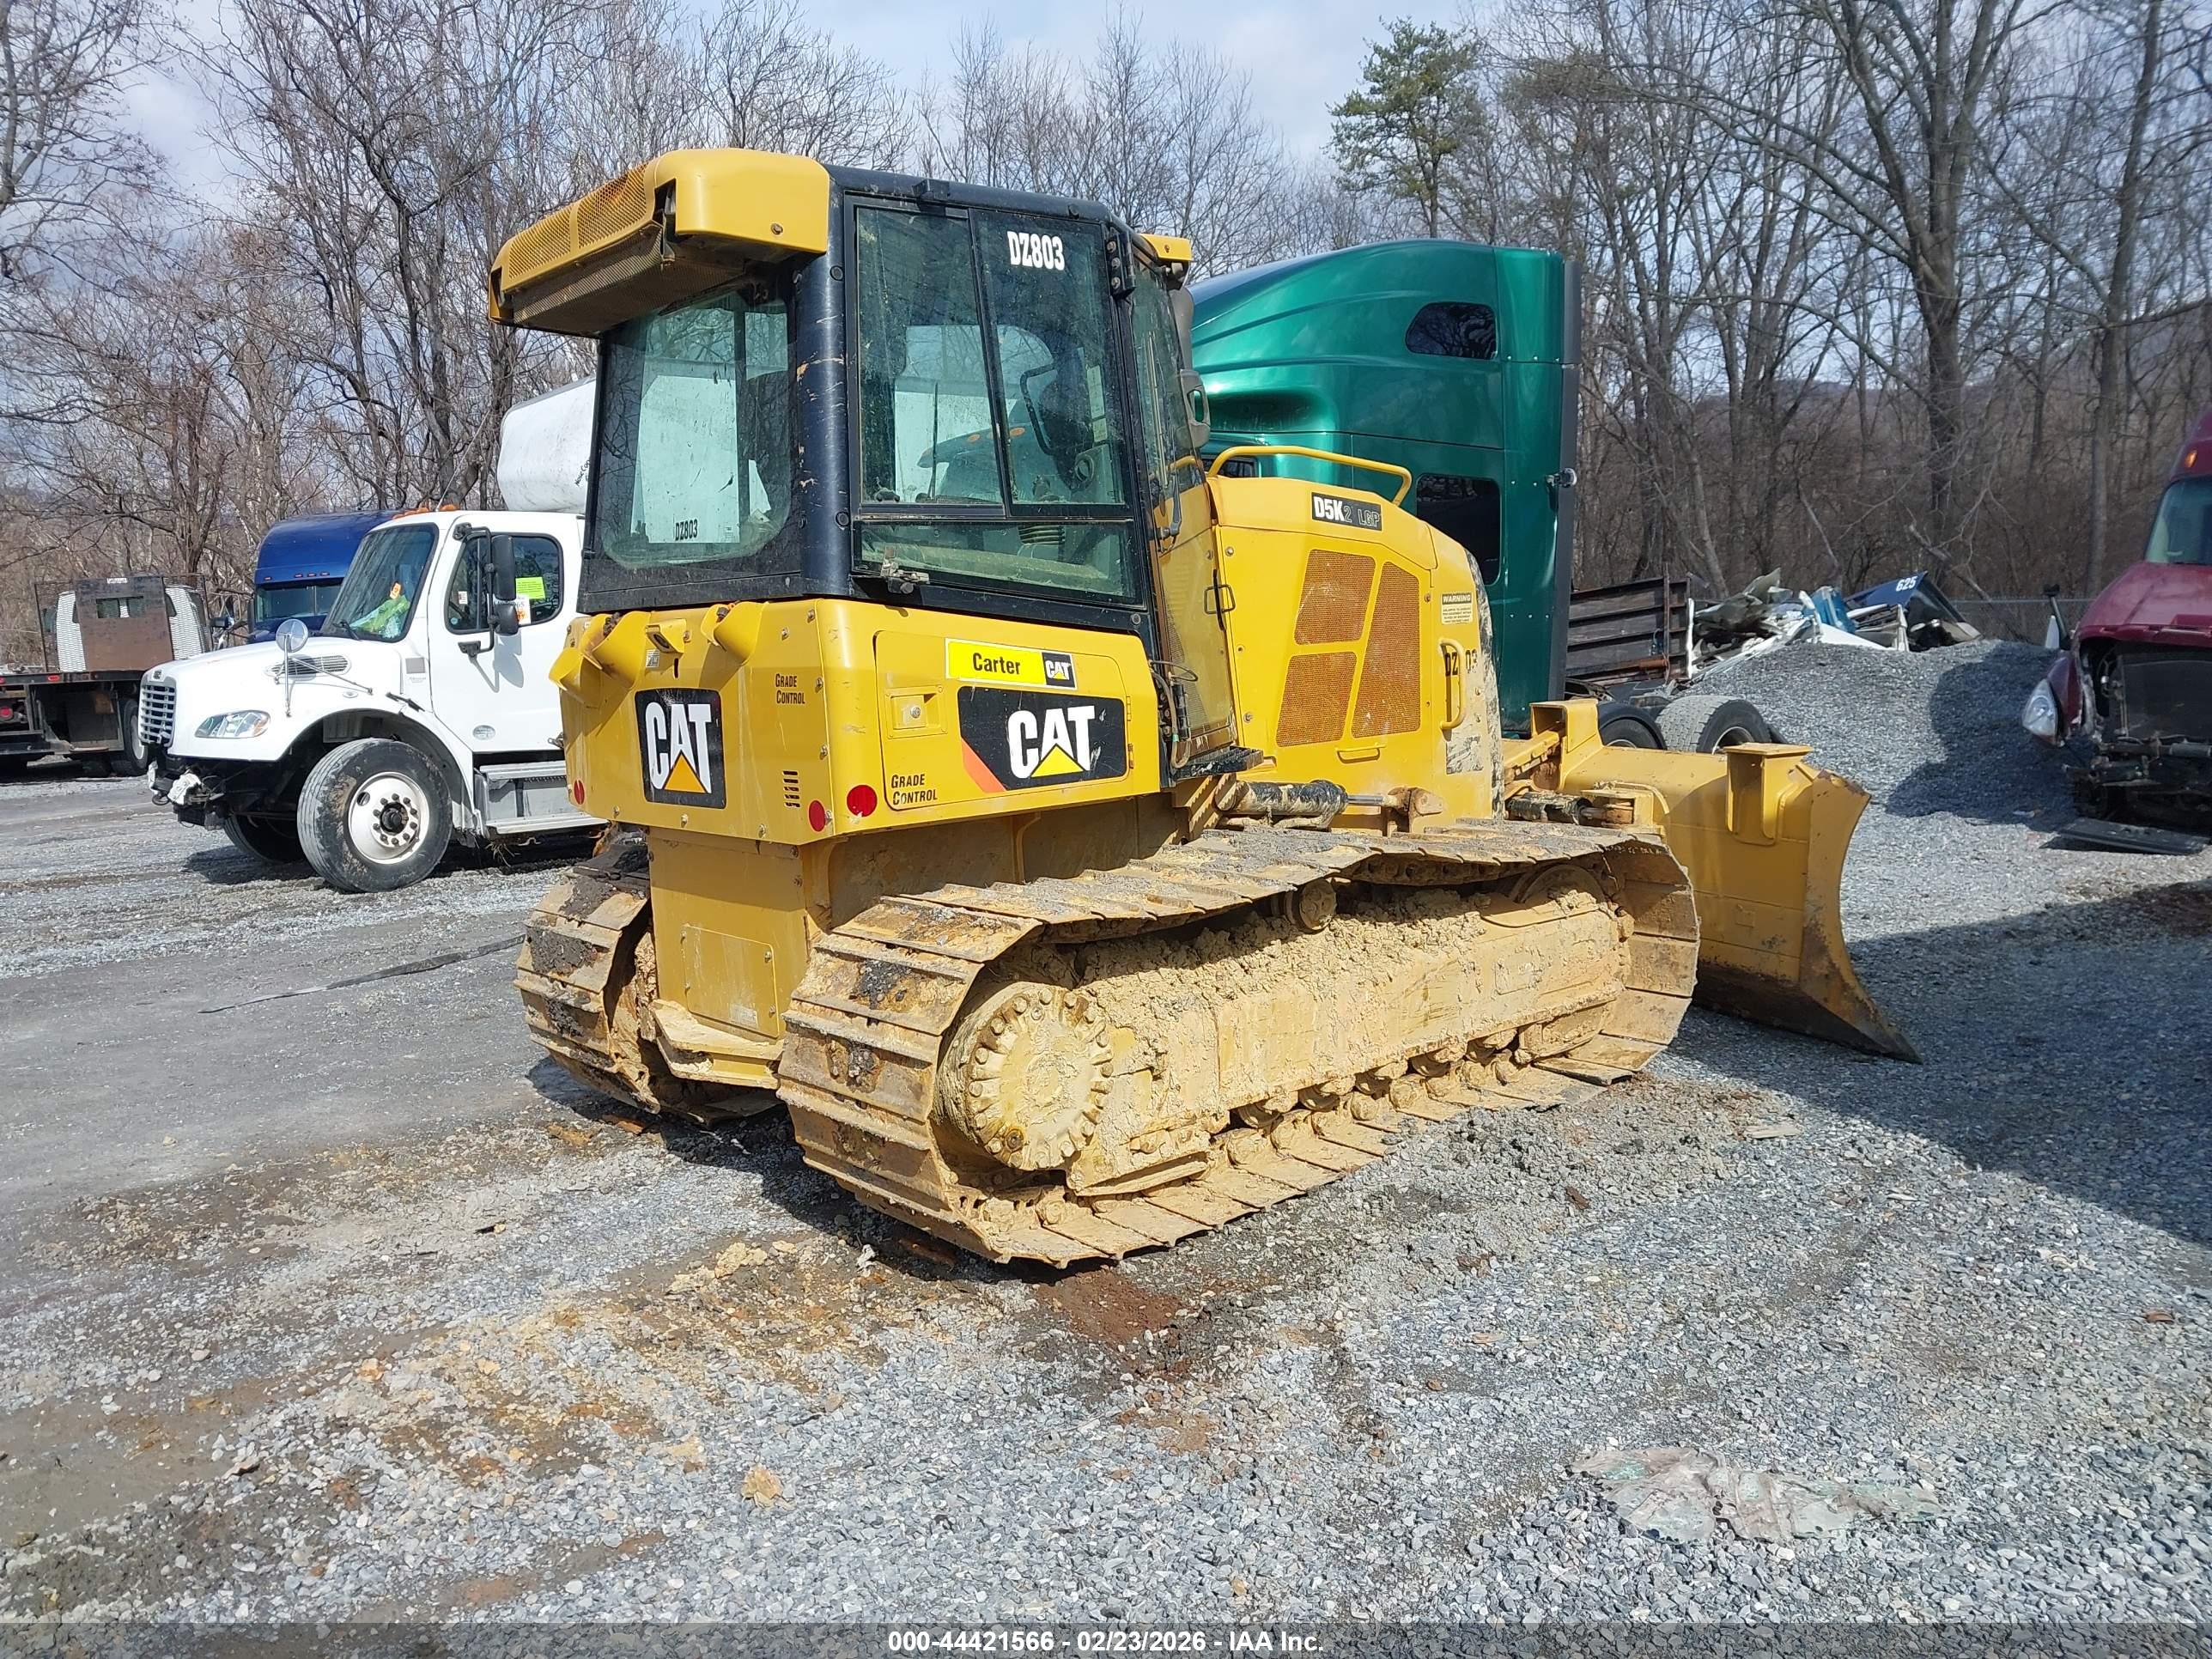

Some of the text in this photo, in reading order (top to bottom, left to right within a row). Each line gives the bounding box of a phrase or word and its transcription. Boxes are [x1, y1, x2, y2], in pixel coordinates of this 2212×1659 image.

[1007, 230, 1065, 271] DZ803
[1357, 508, 1380, 527] LGP
[675, 519, 698, 541] DZ803
[1896, 575, 1918, 592] 625
[1442, 594, 1471, 603] WARNING
[972, 652, 1072, 680] Carter CAT
[1444, 648, 1478, 676] DZ03
[775, 673, 798, 688] GRADE
[776, 690, 805, 704] CONTROL
[645, 702, 713, 794] CAT
[1006, 705, 1096, 780] CAT
[890, 774, 926, 788] GRADE
[892, 789, 938, 805] CONTROL
